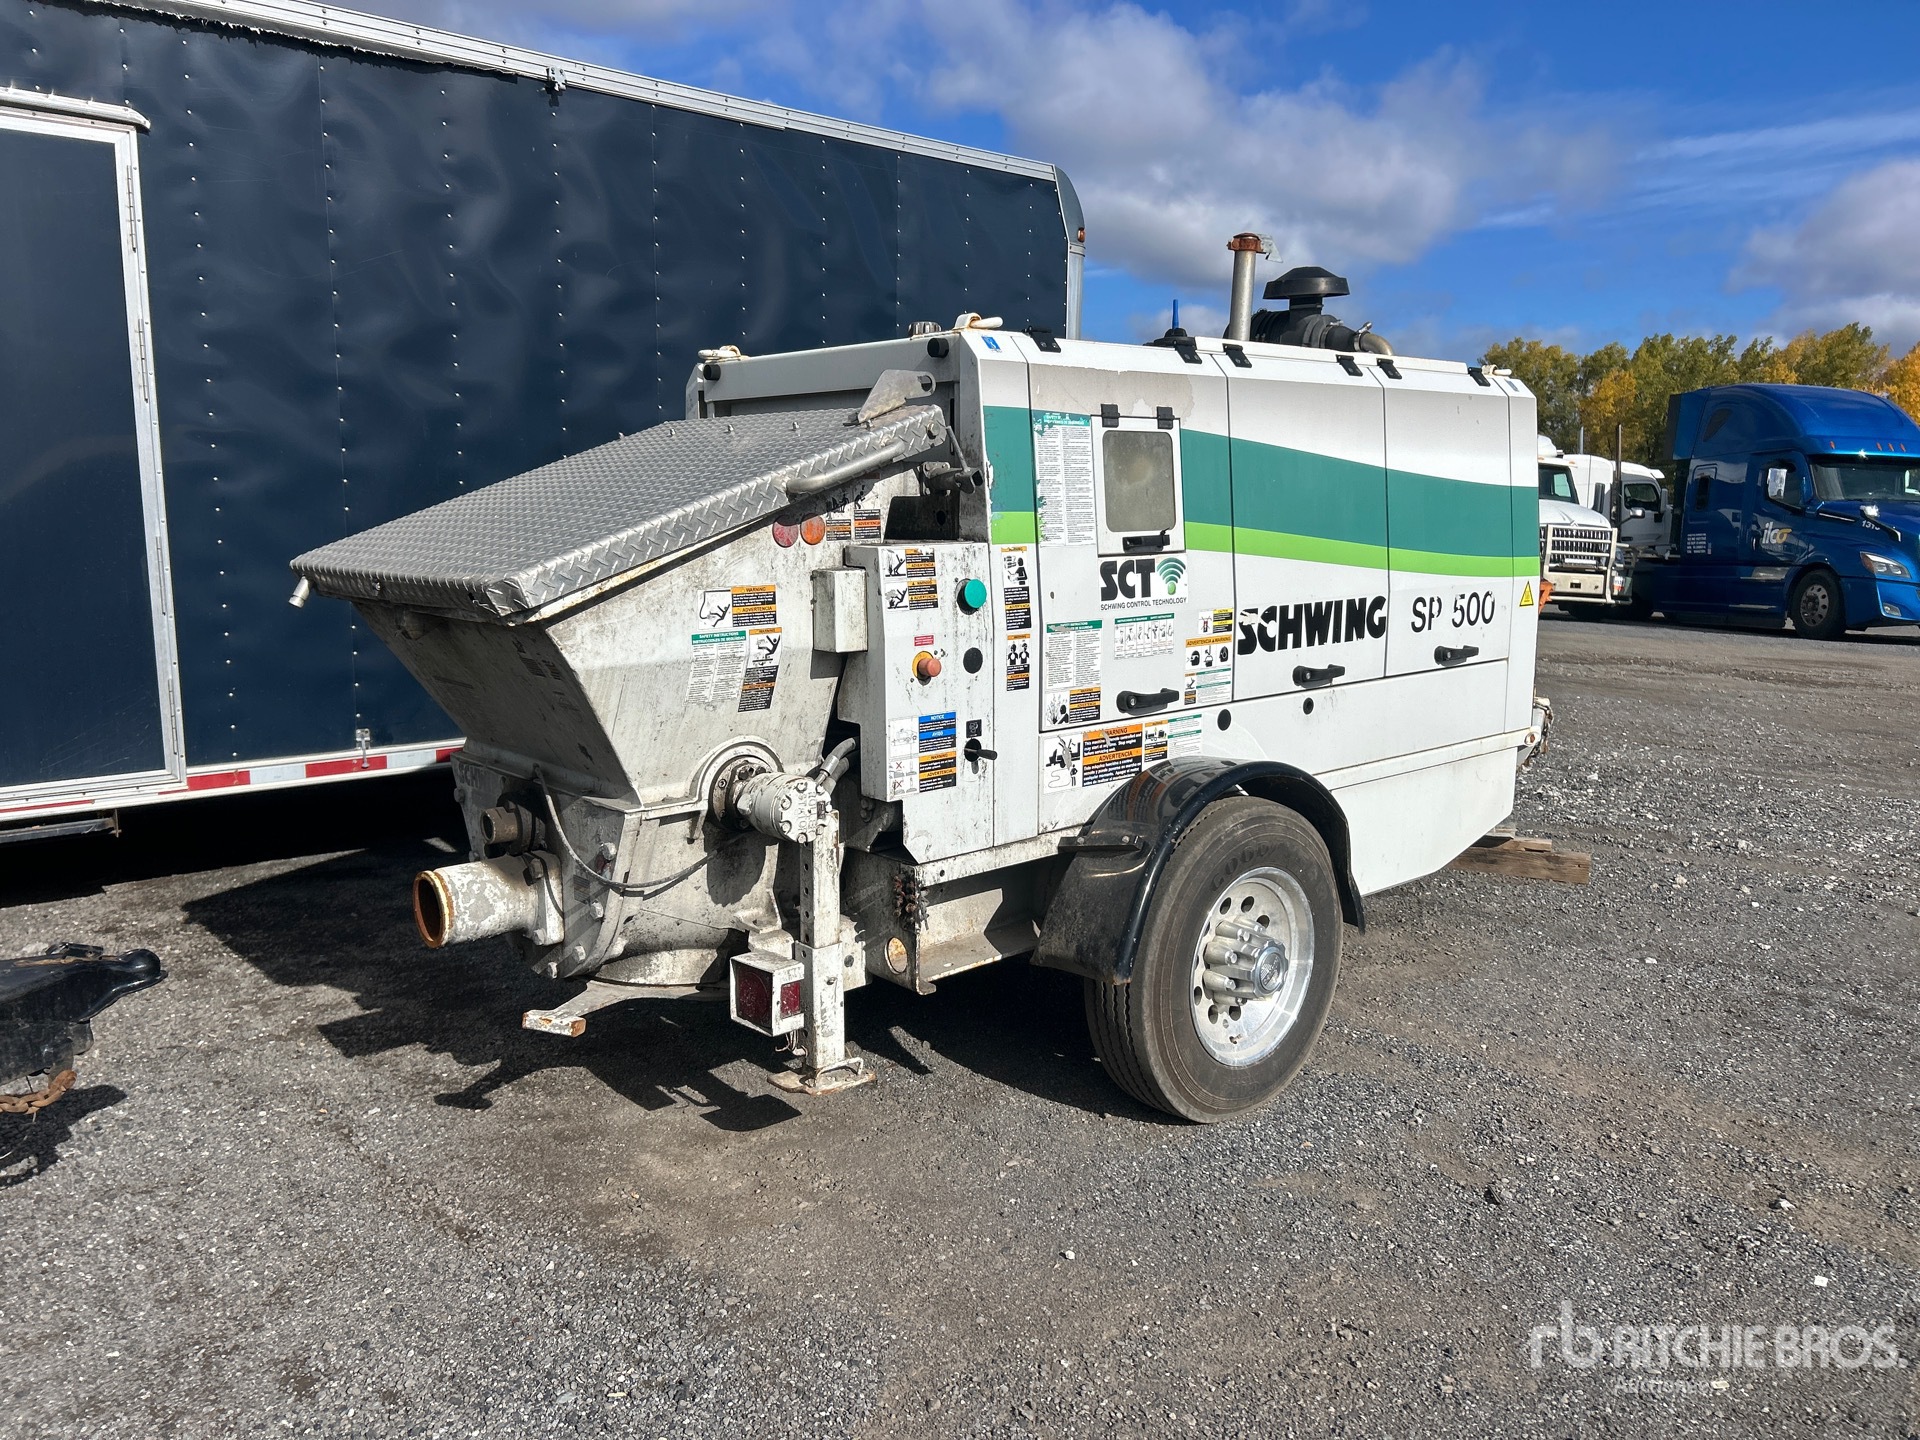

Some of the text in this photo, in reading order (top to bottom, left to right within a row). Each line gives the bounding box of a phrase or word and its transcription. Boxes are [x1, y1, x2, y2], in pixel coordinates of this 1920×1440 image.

[1100, 558, 1156, 602] SCT
[1100, 597, 1187, 610] SCHWING CONTROL TECHNOLOGY
[1411, 590, 1495, 632] SP 500
[1238, 596, 1386, 656] SCHWING
[1099, 752, 1133, 761] ADVERTENCIA
